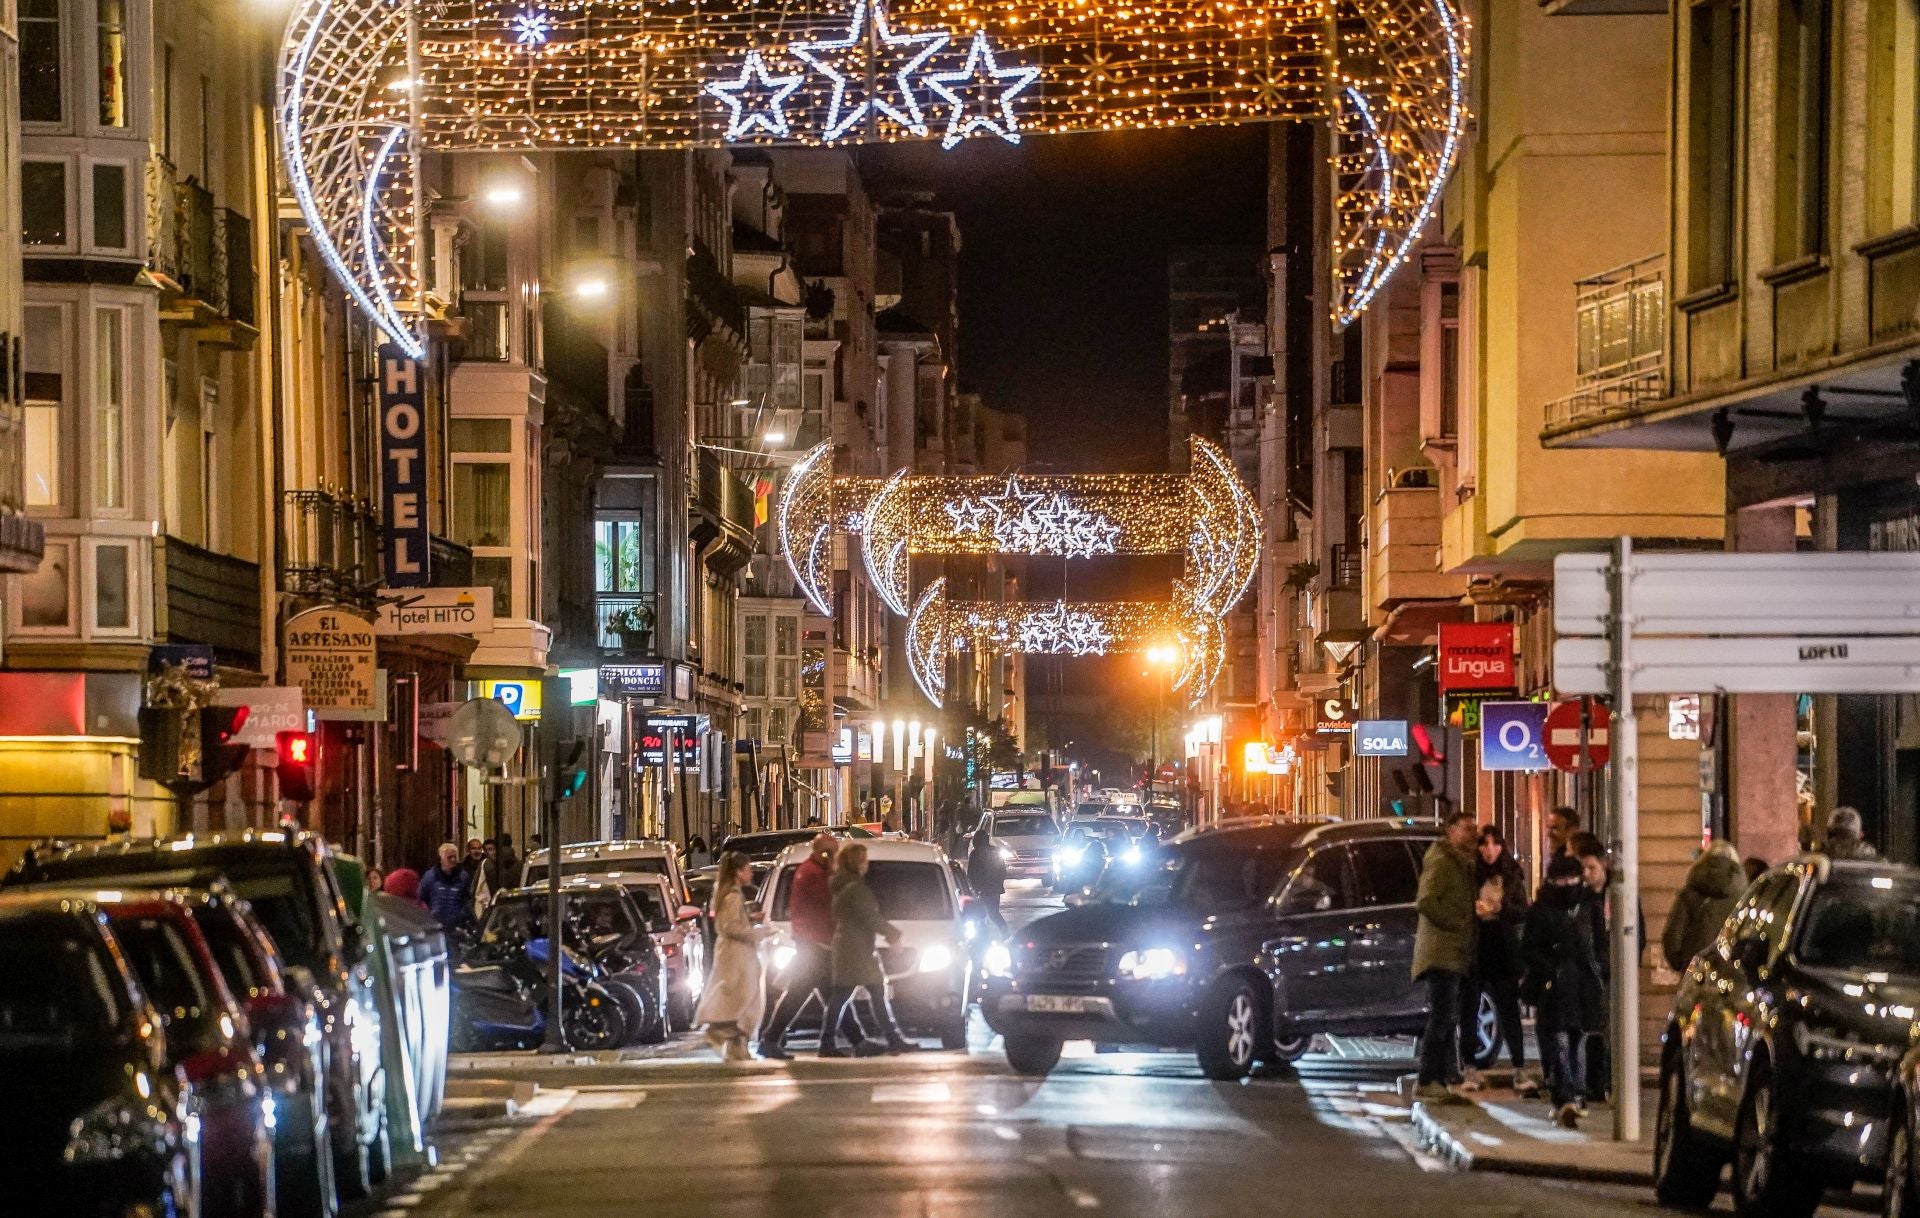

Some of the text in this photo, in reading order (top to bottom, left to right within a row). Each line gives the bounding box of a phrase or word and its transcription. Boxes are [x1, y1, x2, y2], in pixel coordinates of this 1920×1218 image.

[385, 358, 420, 574] HOTEL
[320, 617, 340, 630] EL
[390, 608, 475, 627] Hotel HITO
[289, 632, 372, 647] ARTESANO
[358, 655, 369, 663] DE
[647, 667, 661, 677] DE
[1448, 657, 1505, 678] Lingua
[310, 672, 351, 680] BOLSOS
[298, 680, 362, 688] CINTURONES
[357, 689, 368, 697] DE
[247, 714, 299, 728] MARIO
